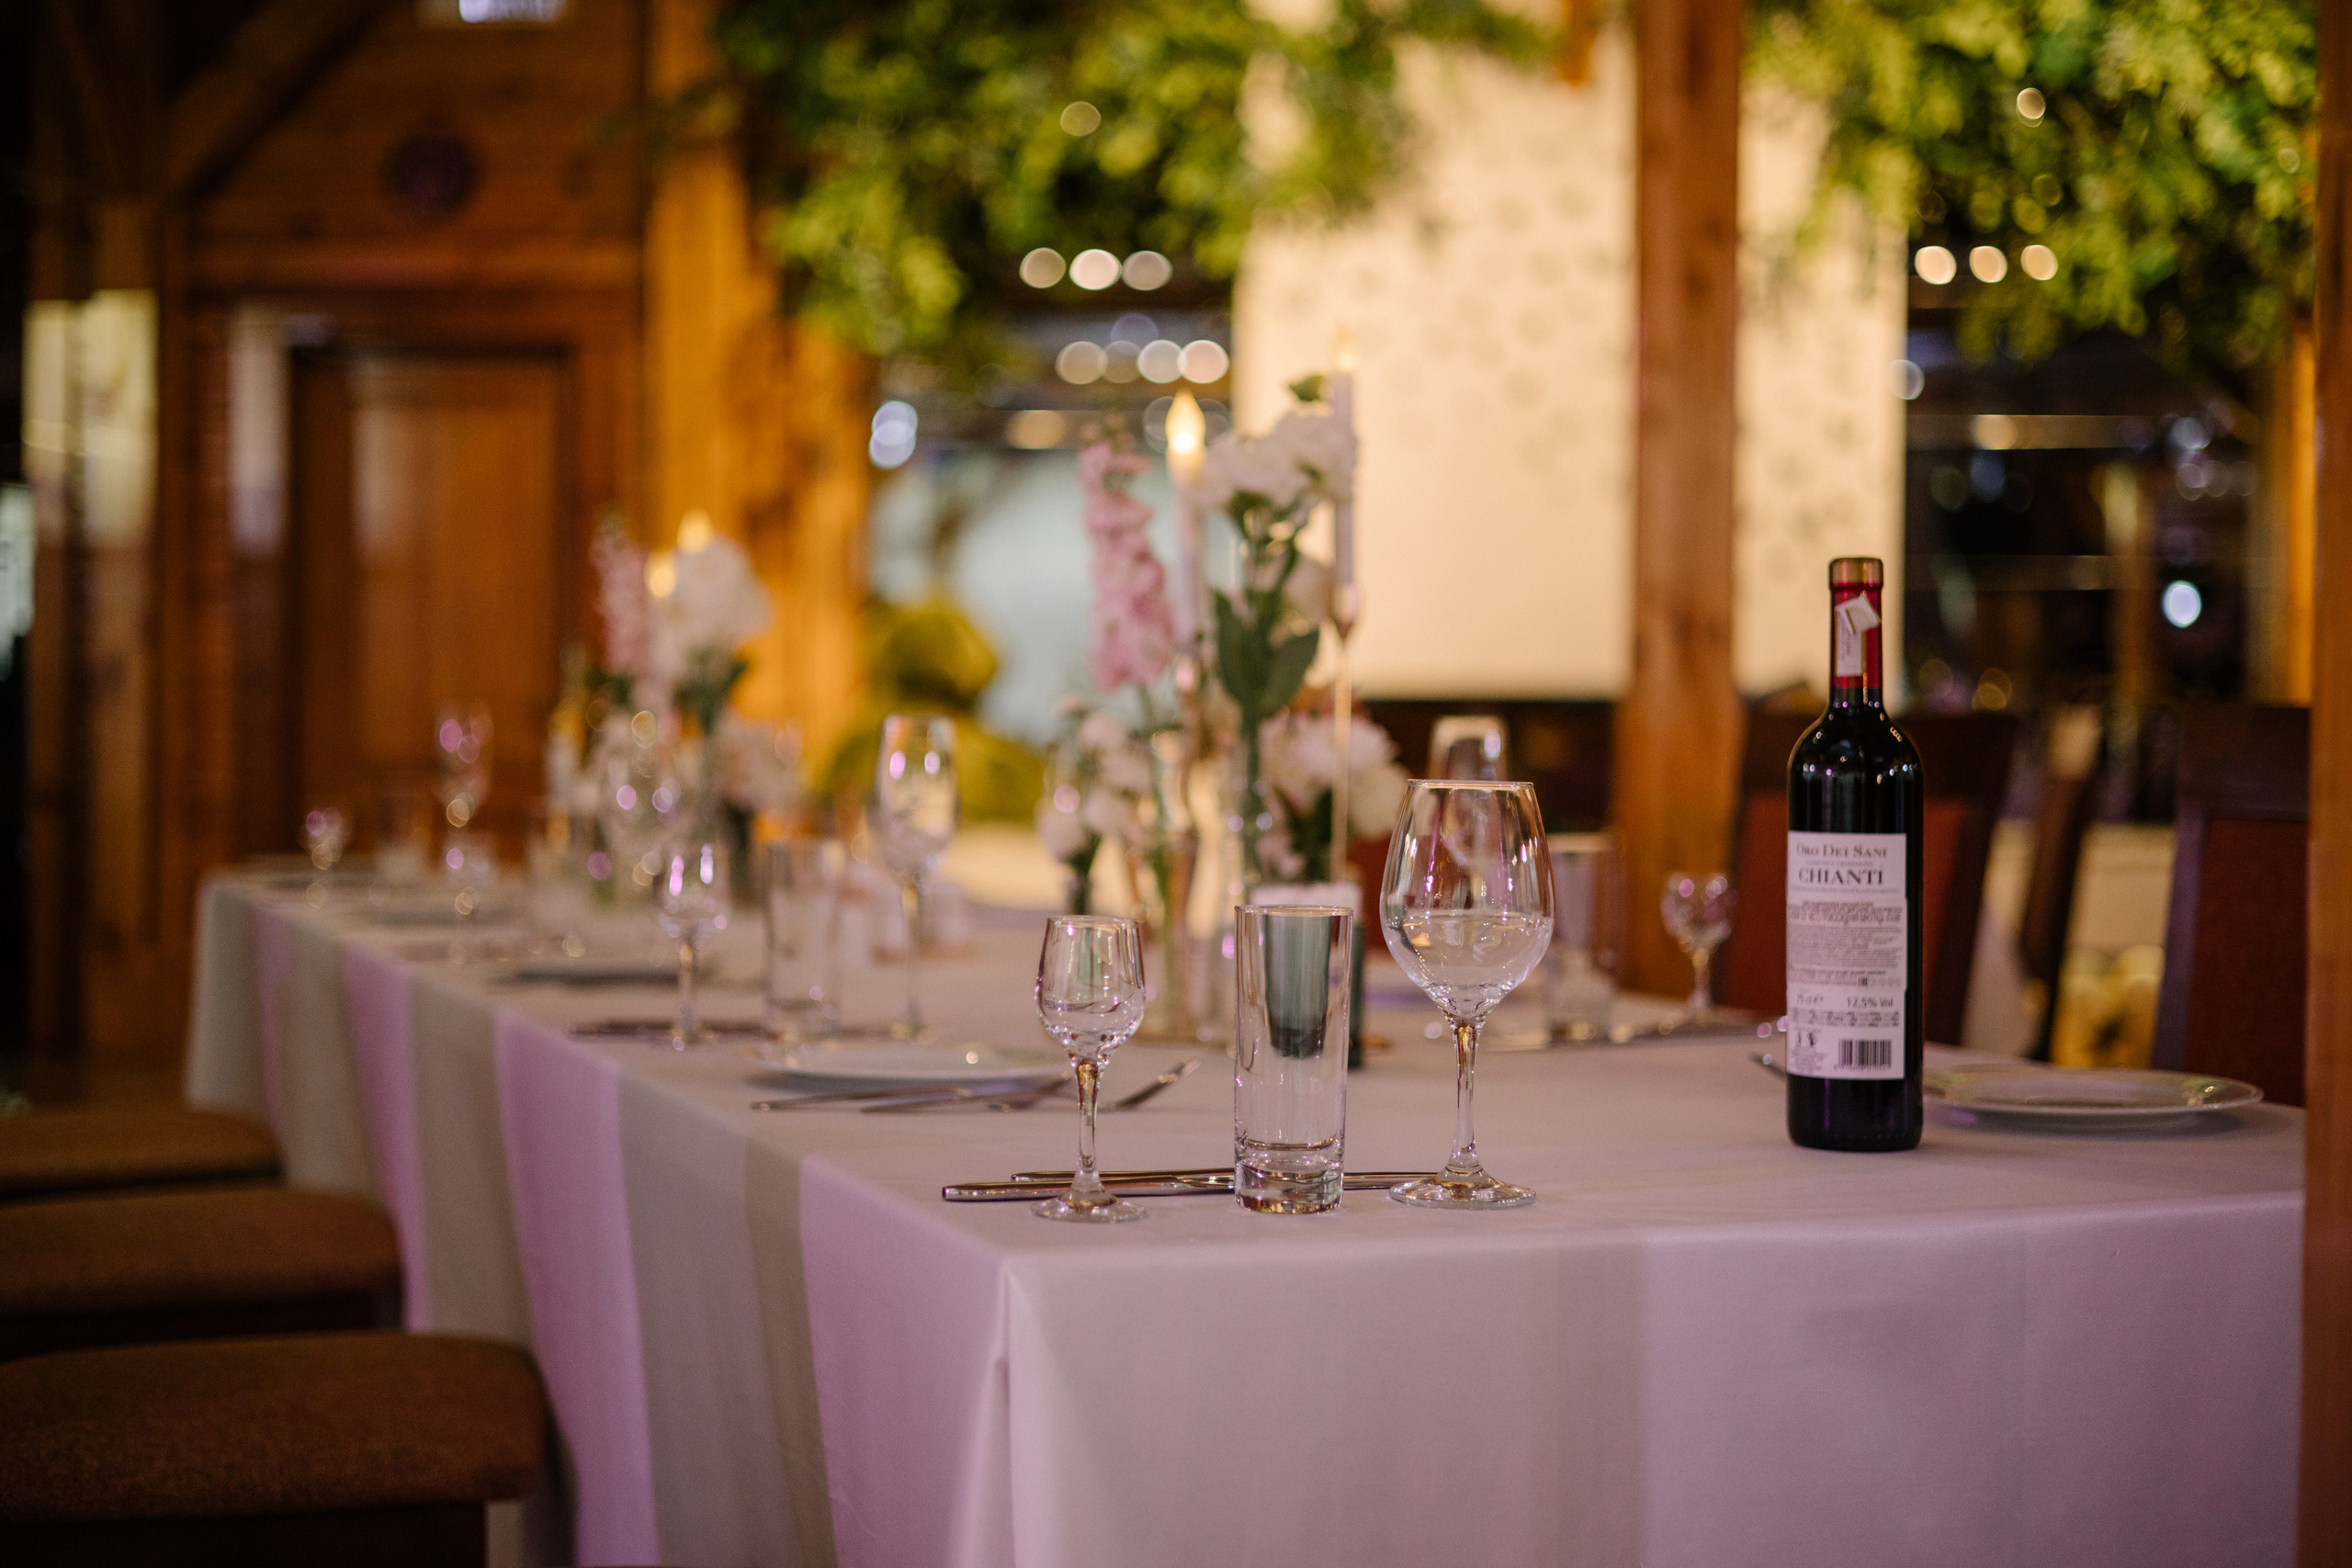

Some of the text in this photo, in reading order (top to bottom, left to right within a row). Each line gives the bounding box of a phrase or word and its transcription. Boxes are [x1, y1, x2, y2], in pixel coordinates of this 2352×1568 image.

[1798, 868, 1883, 885] CHIANTI
[1847, 996, 1894, 1009] 12,5% Vol
